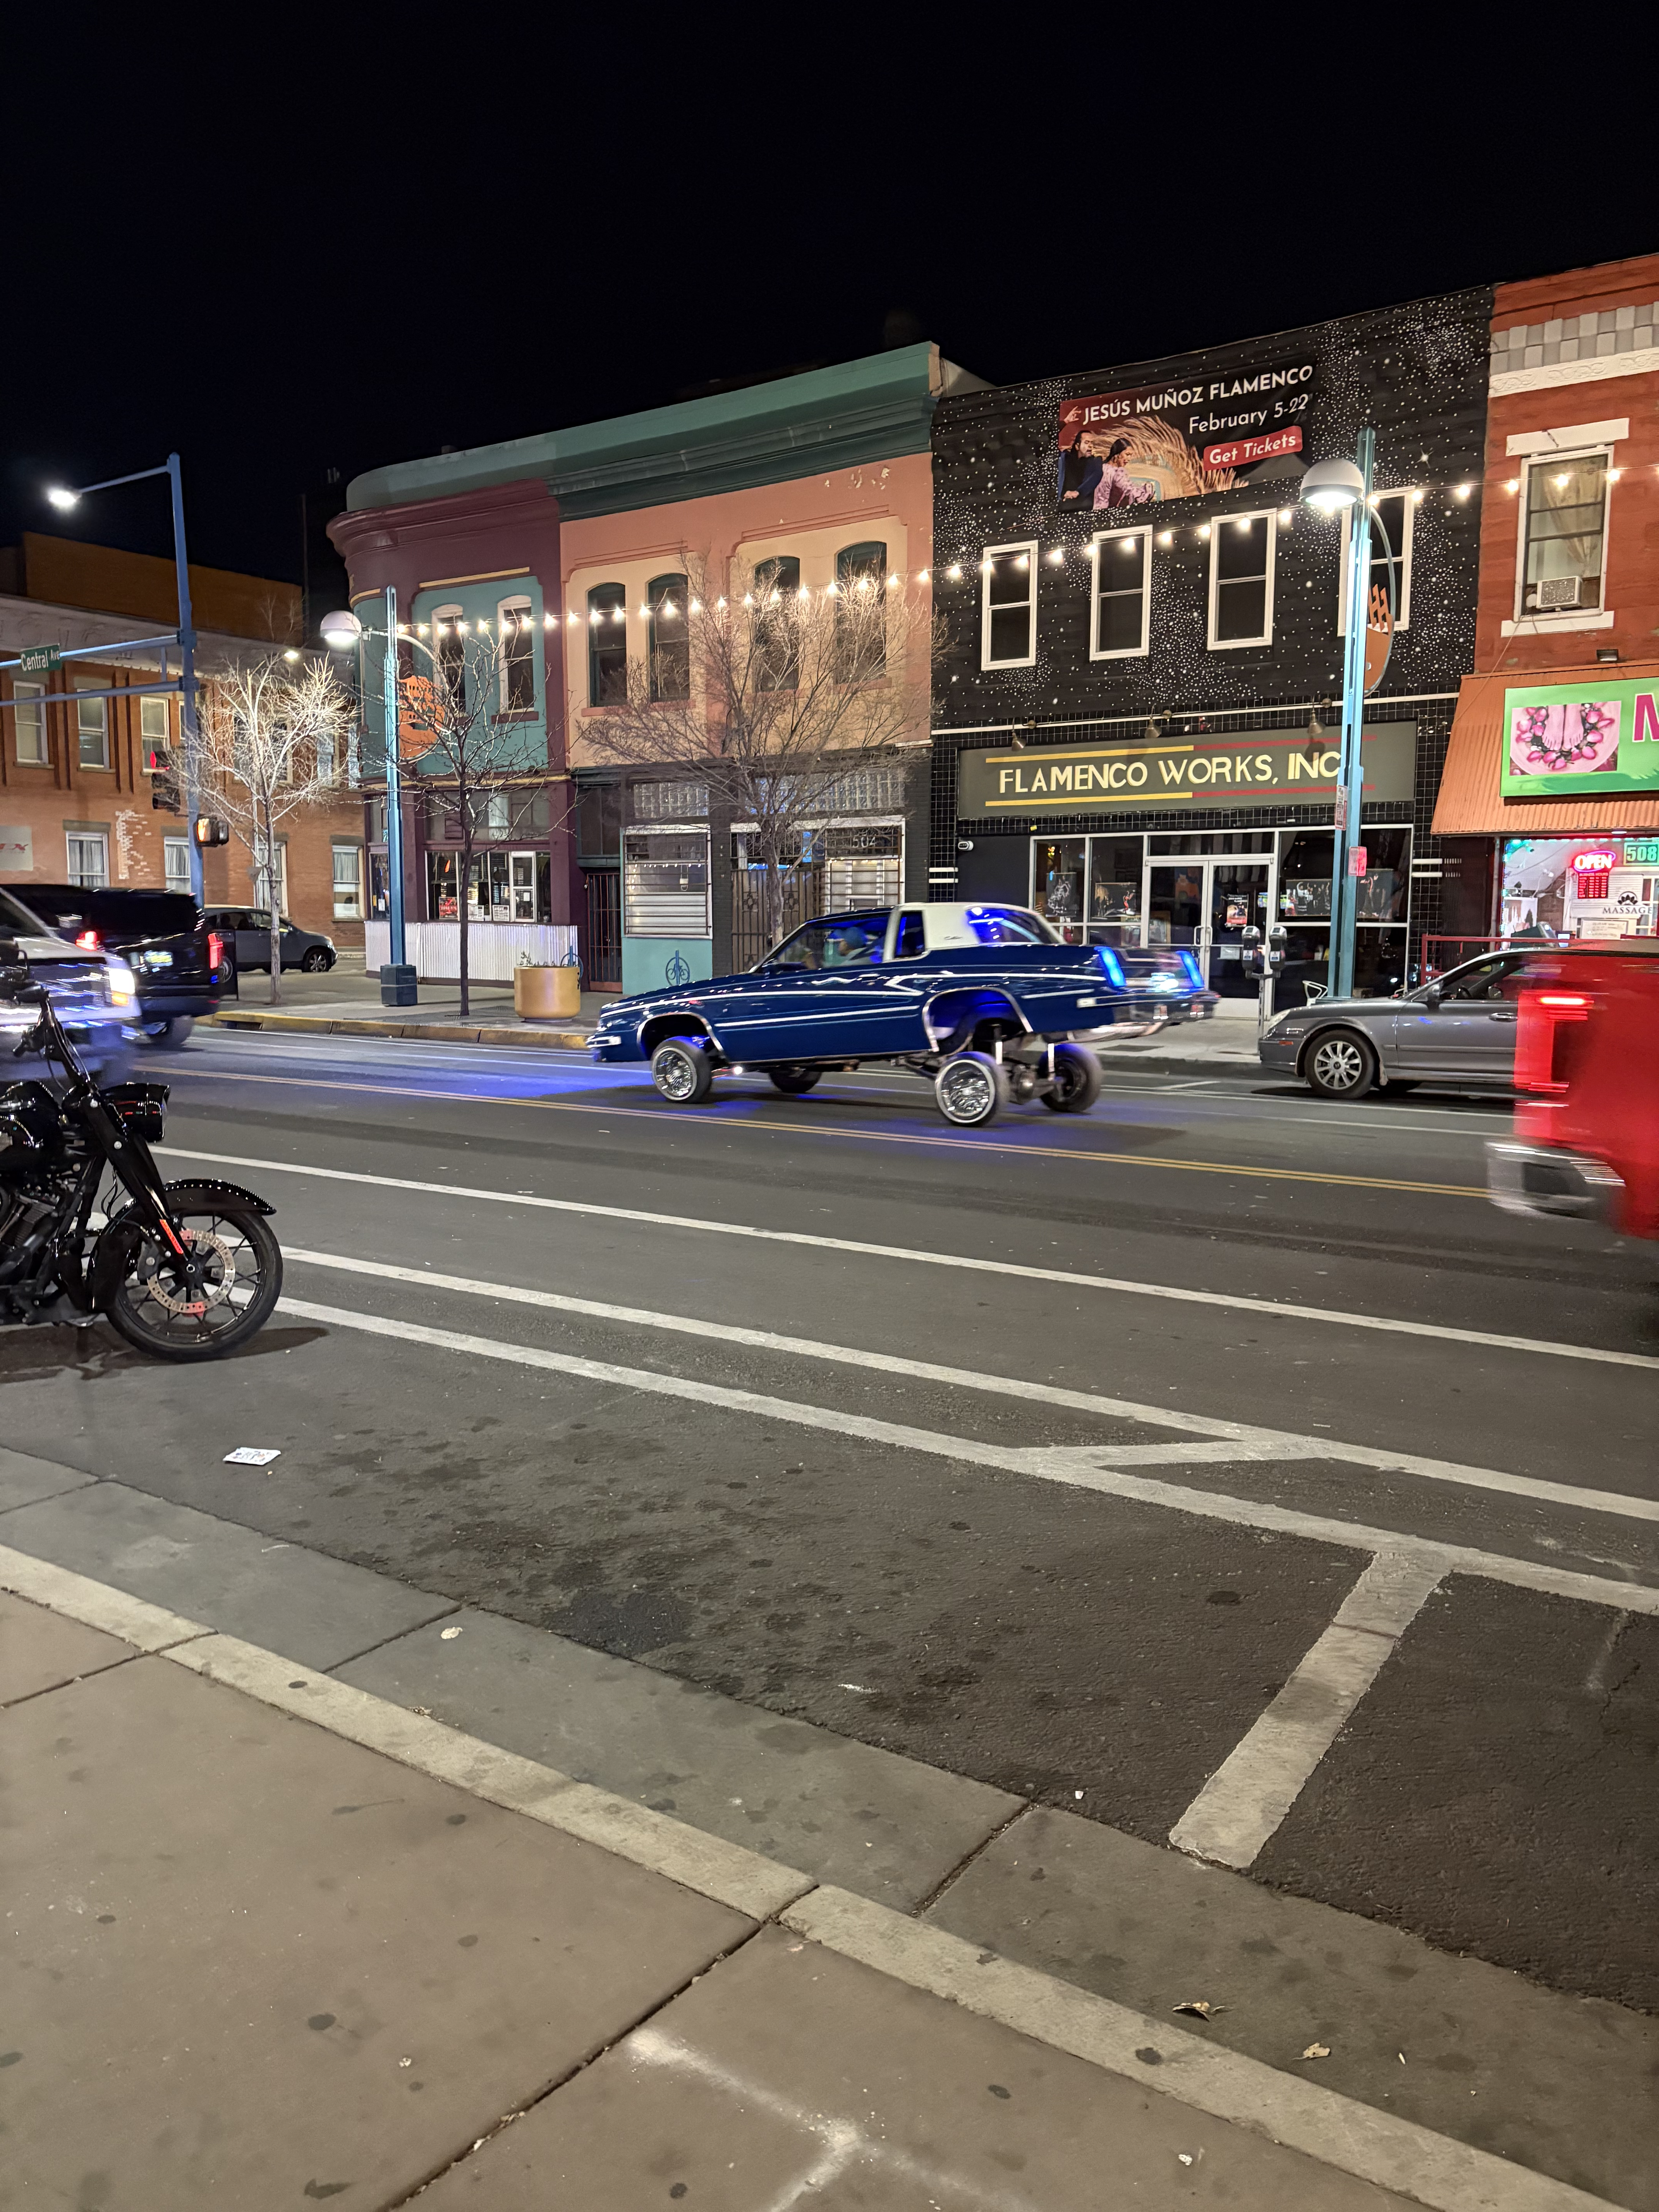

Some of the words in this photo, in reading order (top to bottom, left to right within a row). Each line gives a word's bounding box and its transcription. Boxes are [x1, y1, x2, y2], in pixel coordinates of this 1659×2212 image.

[1083, 399, 1130, 425] JESÚS
[1136, 388, 1204, 413] MUÑOZ
[1210, 365, 1313, 400] FLAMENCO
[1189, 410, 1268, 434] February
[1274, 393, 1309, 418] 5-22
[1210, 447, 1238, 464] Get
[1243, 434, 1296, 458] Tickets
[21, 650, 48, 671] Central
[1000, 762, 1147, 793] FLAMENCO
[1158, 754, 1278, 785] WORKS,
[852, 834, 876, 848] 504
[1626, 846, 1657, 861] 508
[1575, 854, 1612, 870] OPEN
